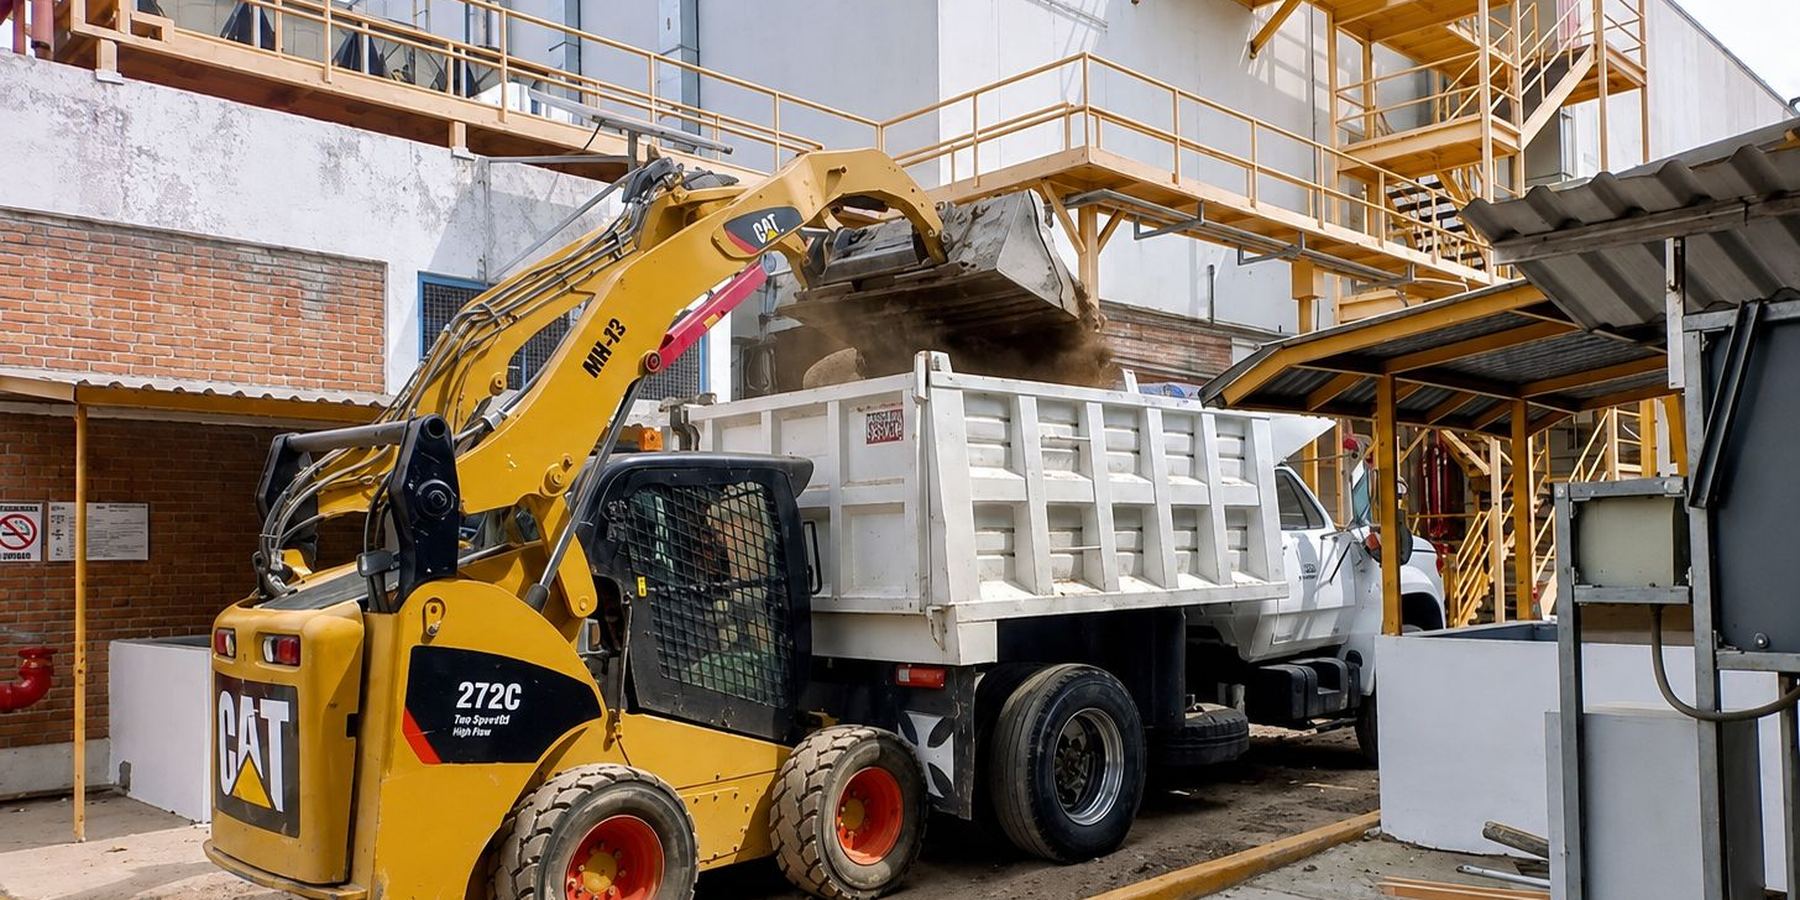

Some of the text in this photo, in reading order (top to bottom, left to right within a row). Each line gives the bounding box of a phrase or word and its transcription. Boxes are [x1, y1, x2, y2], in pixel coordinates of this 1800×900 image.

[752, 213, 780, 244] CAT
[582, 317, 626, 379] MH-13
[455, 681, 522, 711] 272C
[218, 690, 290, 813] CAT
